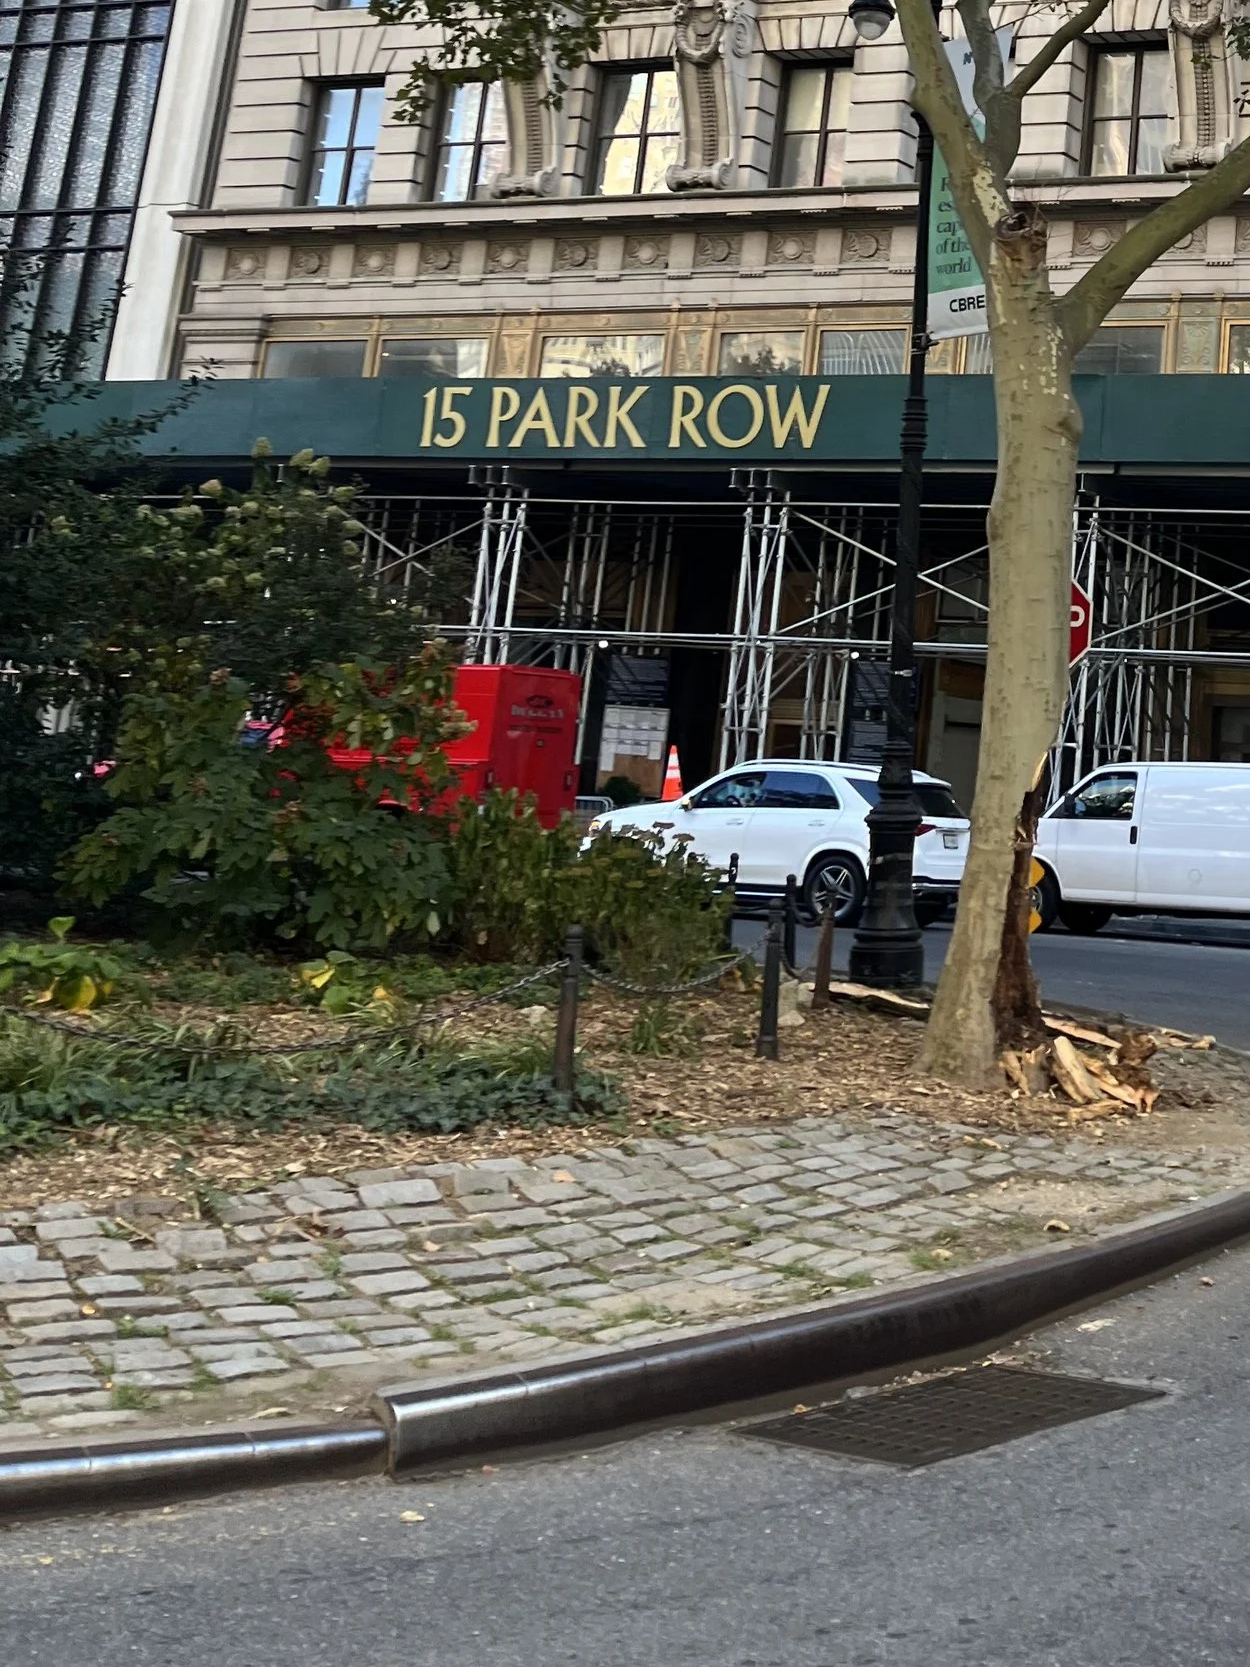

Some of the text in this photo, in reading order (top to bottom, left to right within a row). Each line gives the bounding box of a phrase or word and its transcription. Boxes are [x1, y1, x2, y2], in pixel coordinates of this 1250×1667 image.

[935, 237, 951, 255] of
[935, 256, 972, 275] world
[949, 294, 986, 313] CBRE
[418, 384, 832, 449] 15 PARK ROW
